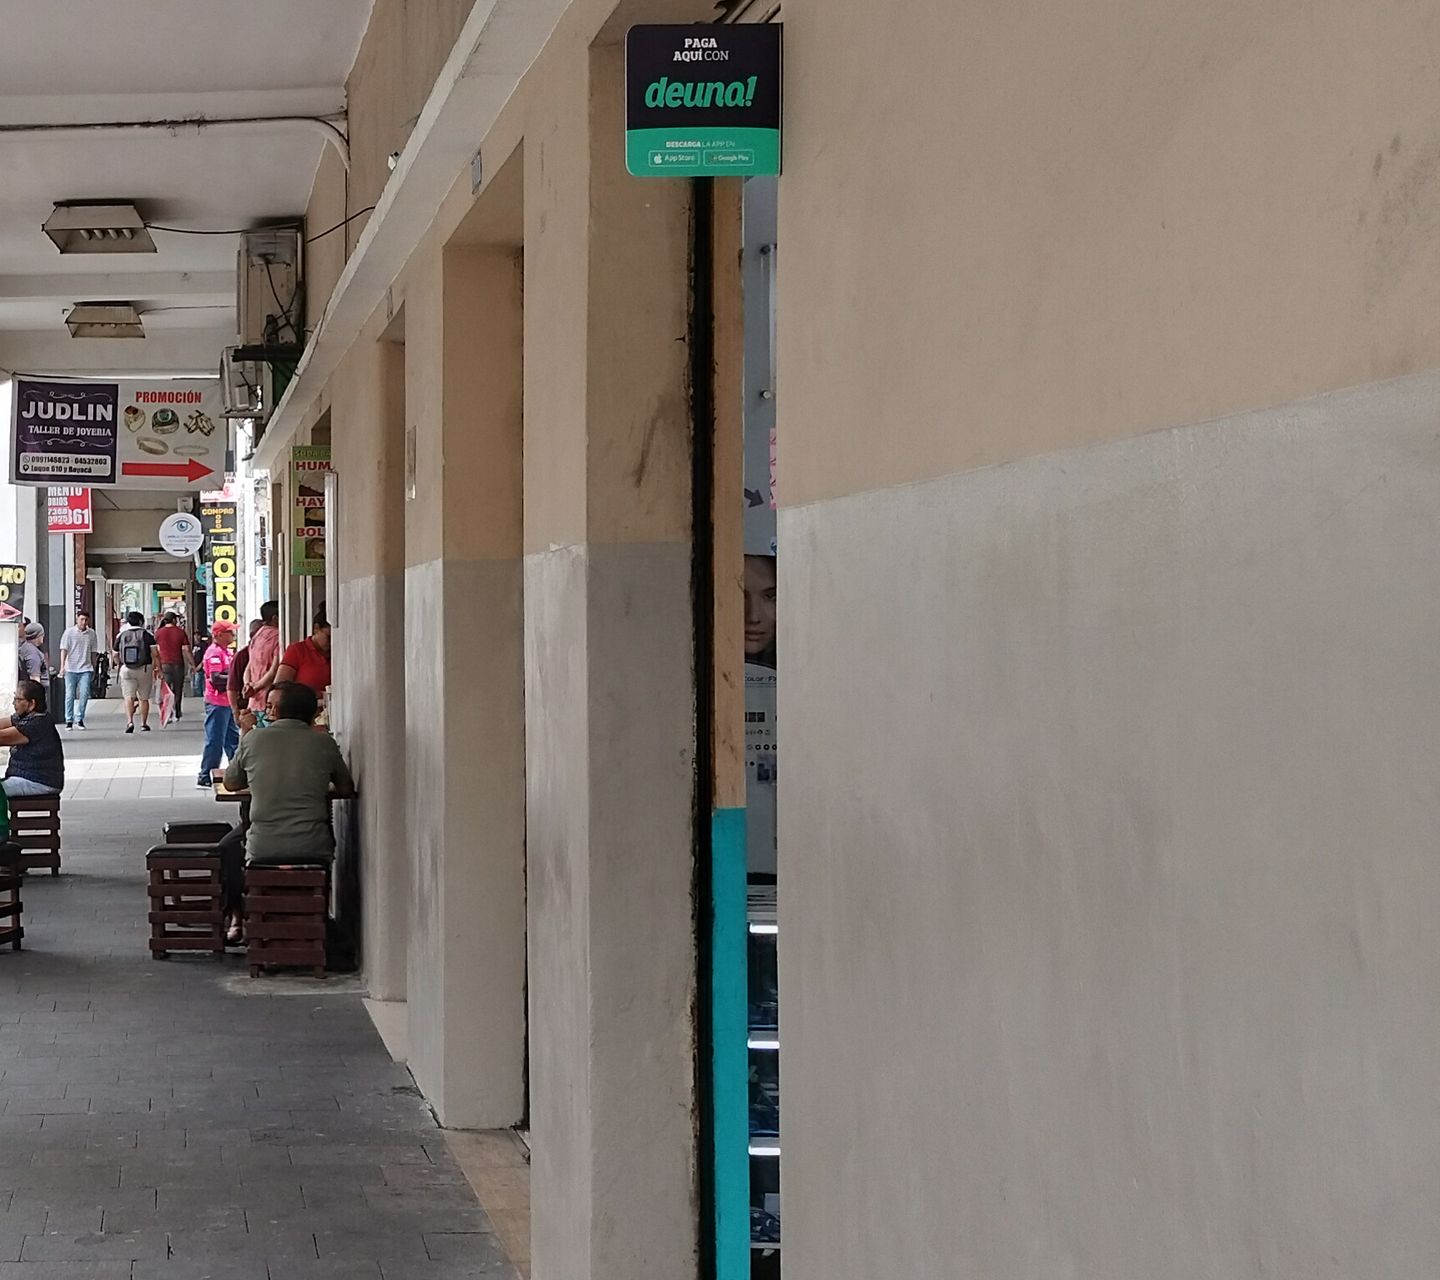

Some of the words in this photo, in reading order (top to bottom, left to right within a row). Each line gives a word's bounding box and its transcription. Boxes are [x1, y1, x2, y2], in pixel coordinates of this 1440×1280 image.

[684, 38, 718, 49] PAGA
[673, 48, 703, 62] AQUÍ
[704, 50, 730, 61] CON
[645, 75, 758, 108] deuna!
[135, 389, 202, 404] PROMOCIÓN
[21, 401, 113, 421] JUDLIN
[28, 425, 61, 435] TALLER
[62, 426, 74, 436] DE
[75, 426, 112, 437] JOYERIA
[213, 557, 237, 624] ORO
